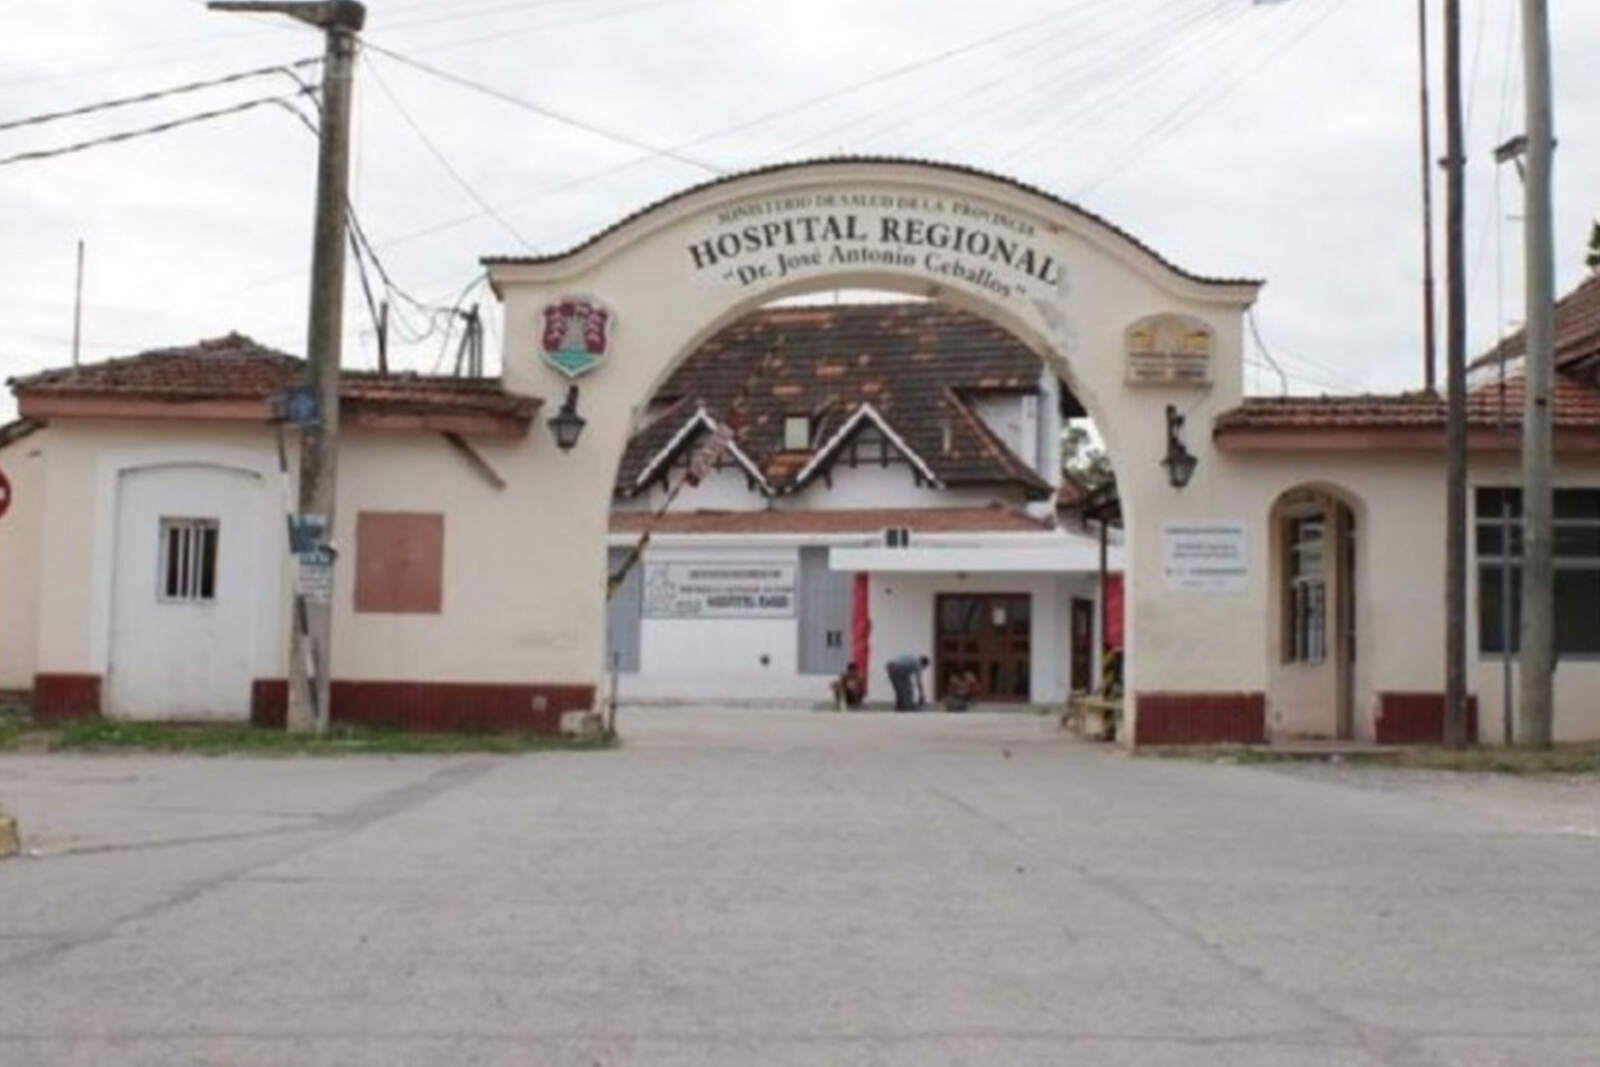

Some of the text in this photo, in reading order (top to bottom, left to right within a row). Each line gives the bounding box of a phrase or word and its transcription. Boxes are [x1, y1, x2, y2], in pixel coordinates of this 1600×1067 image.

[688, 214, 1058, 285] HOSPITAL REGIONAL
[777, 252, 823, 277] José
[829, 245, 916, 266] Antonio
